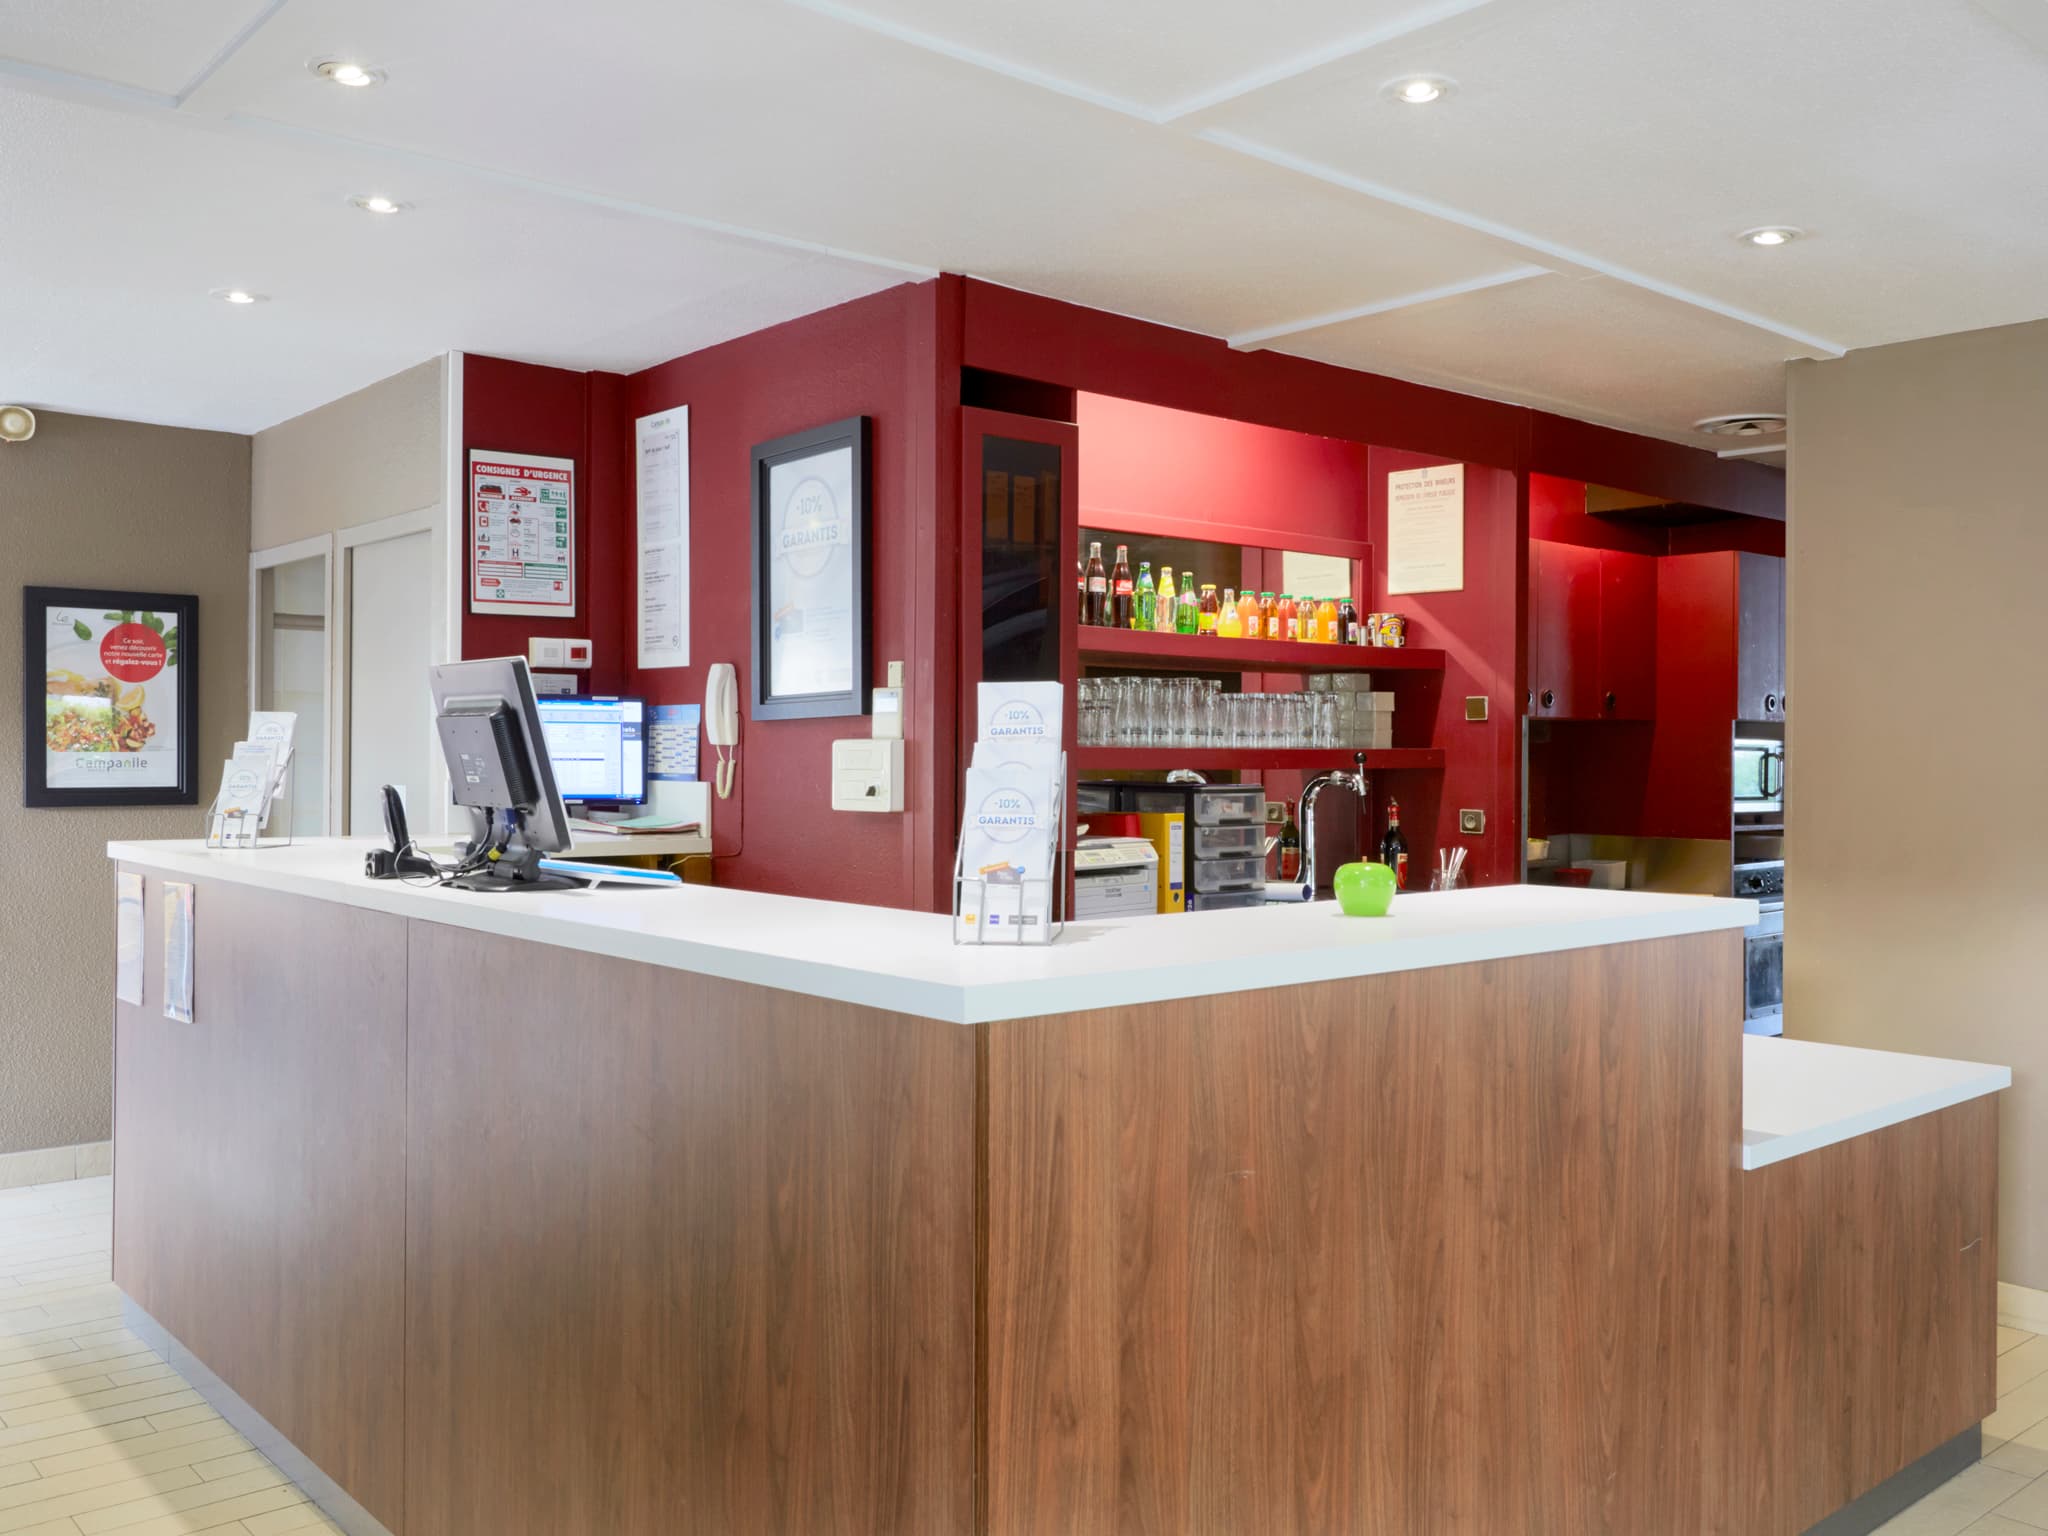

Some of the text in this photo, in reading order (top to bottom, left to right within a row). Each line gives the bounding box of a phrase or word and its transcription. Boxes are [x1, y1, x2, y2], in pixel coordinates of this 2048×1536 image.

[476, 464, 568, 481] CONSIGNES D'URGENCE
[796, 495, 822, 515] -10%
[783, 525, 838, 549] GARANTIS
[1004, 710, 1030, 720] -10%
[990, 726, 1044, 736] GARANTIS
[75, 757, 149, 773] Campanile
[994, 798, 1021, 809] -10%
[978, 815, 1035, 826] GARANTIS
